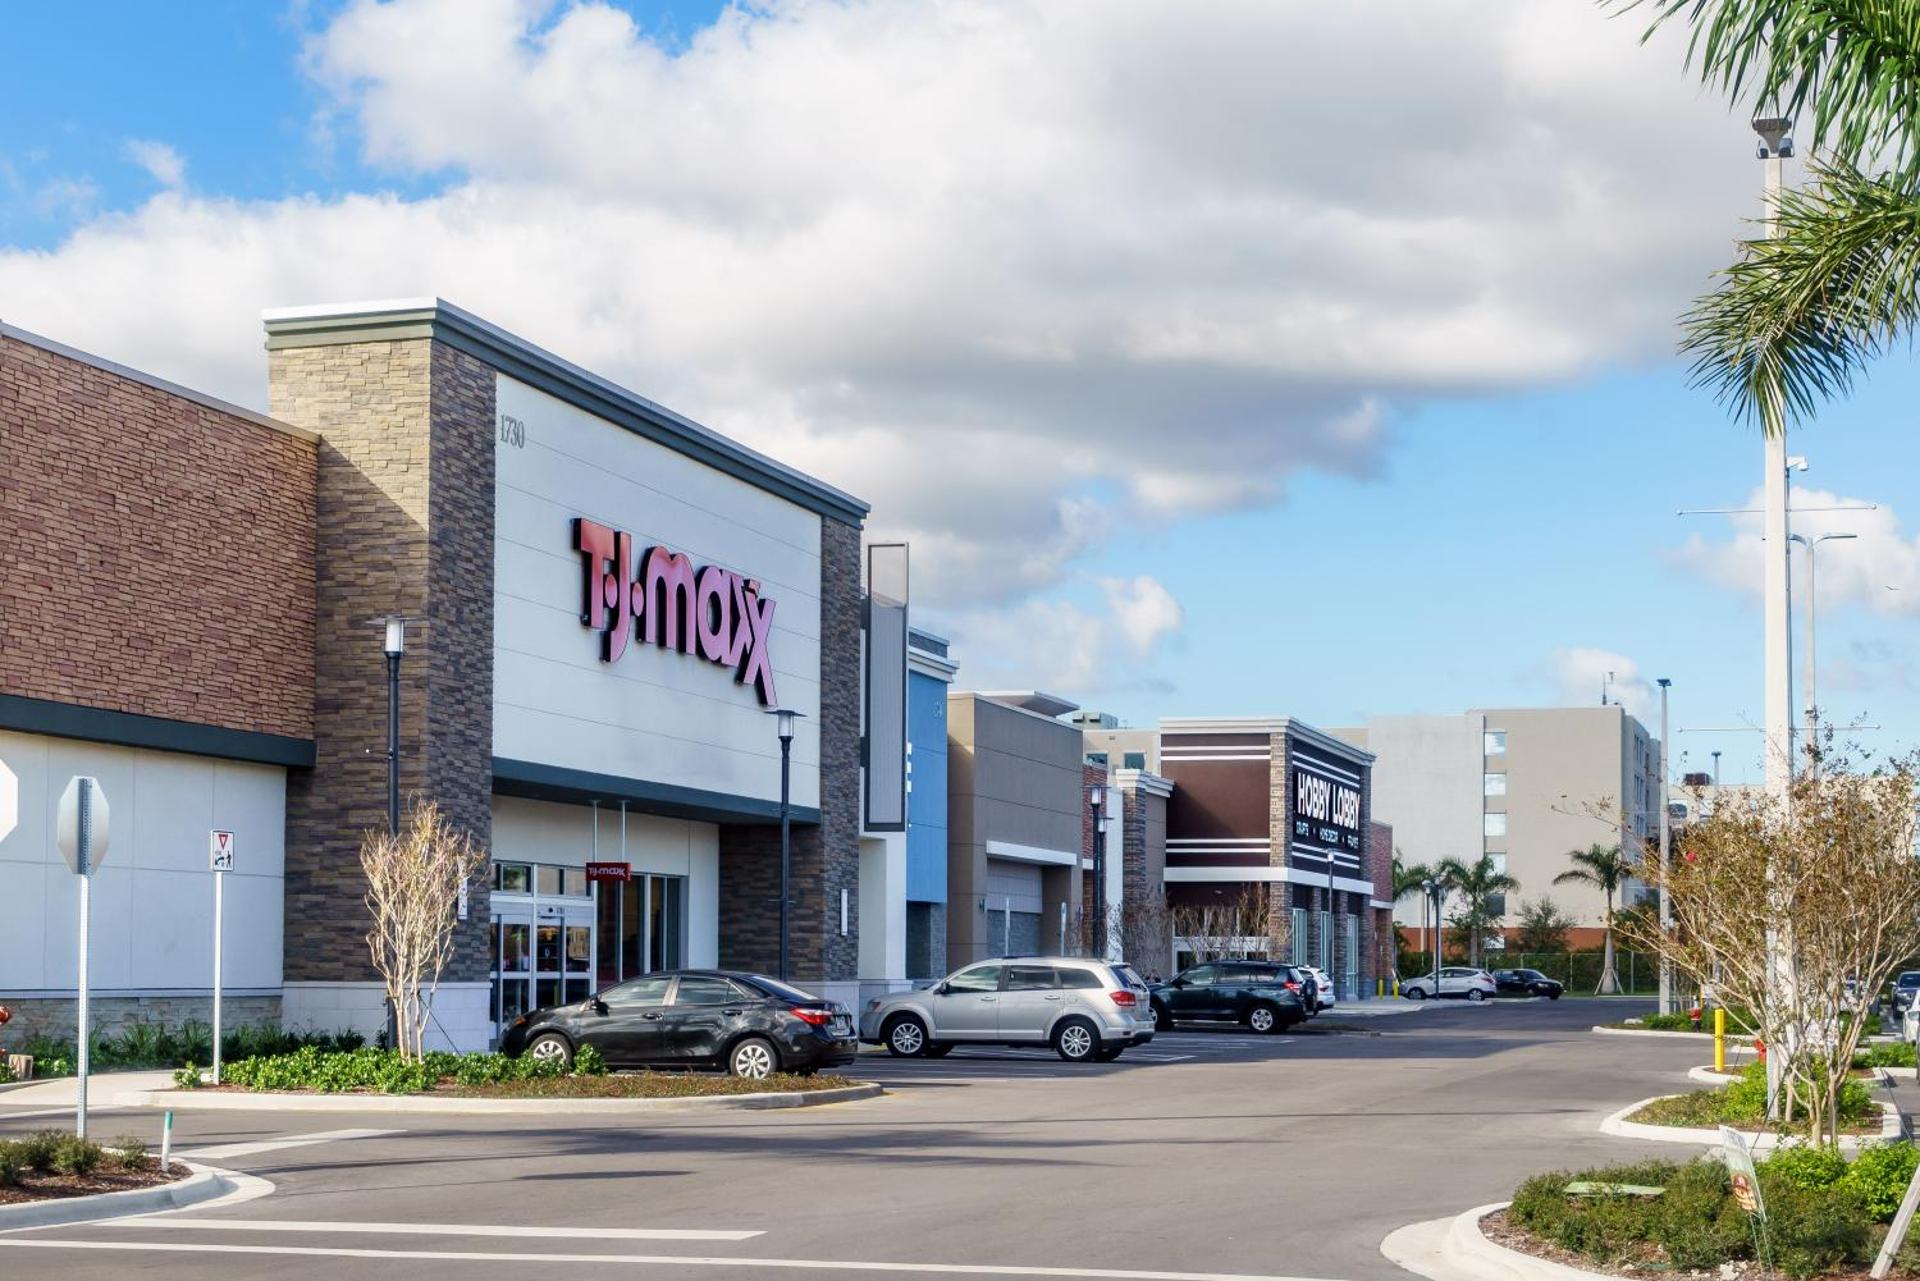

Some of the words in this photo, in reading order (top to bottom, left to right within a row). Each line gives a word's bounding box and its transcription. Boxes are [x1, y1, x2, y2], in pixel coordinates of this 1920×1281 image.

[500, 415, 525, 449] 1730
[1298, 772, 1331, 822] HOBBY
[1332, 784, 1361, 831] LOBBY
